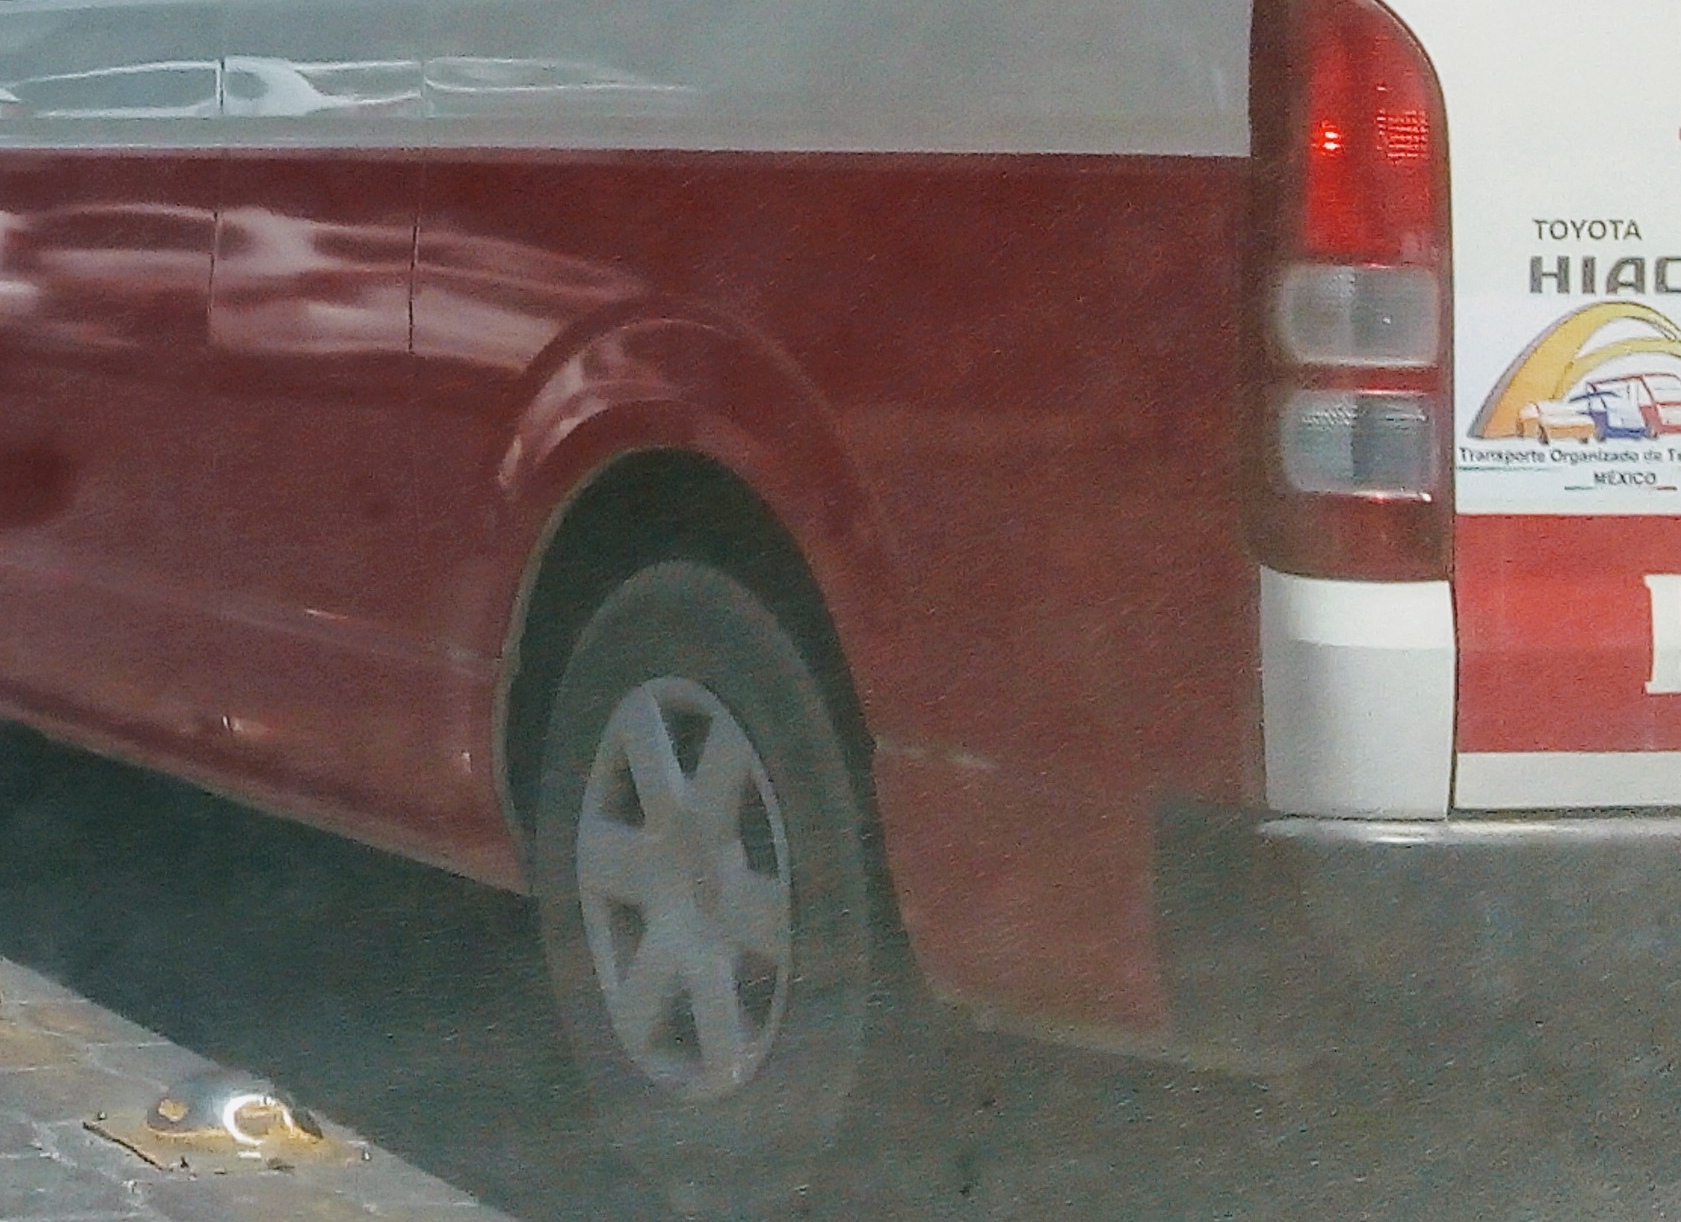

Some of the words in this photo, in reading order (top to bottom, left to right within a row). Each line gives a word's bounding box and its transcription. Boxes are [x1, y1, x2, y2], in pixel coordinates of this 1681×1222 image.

[1532, 219, 1642, 242] TOYOTA
[1458, 446, 1545, 465] Transporte
[1550, 446, 1640, 465] Organizado
[1644, 447, 1663, 463] de
